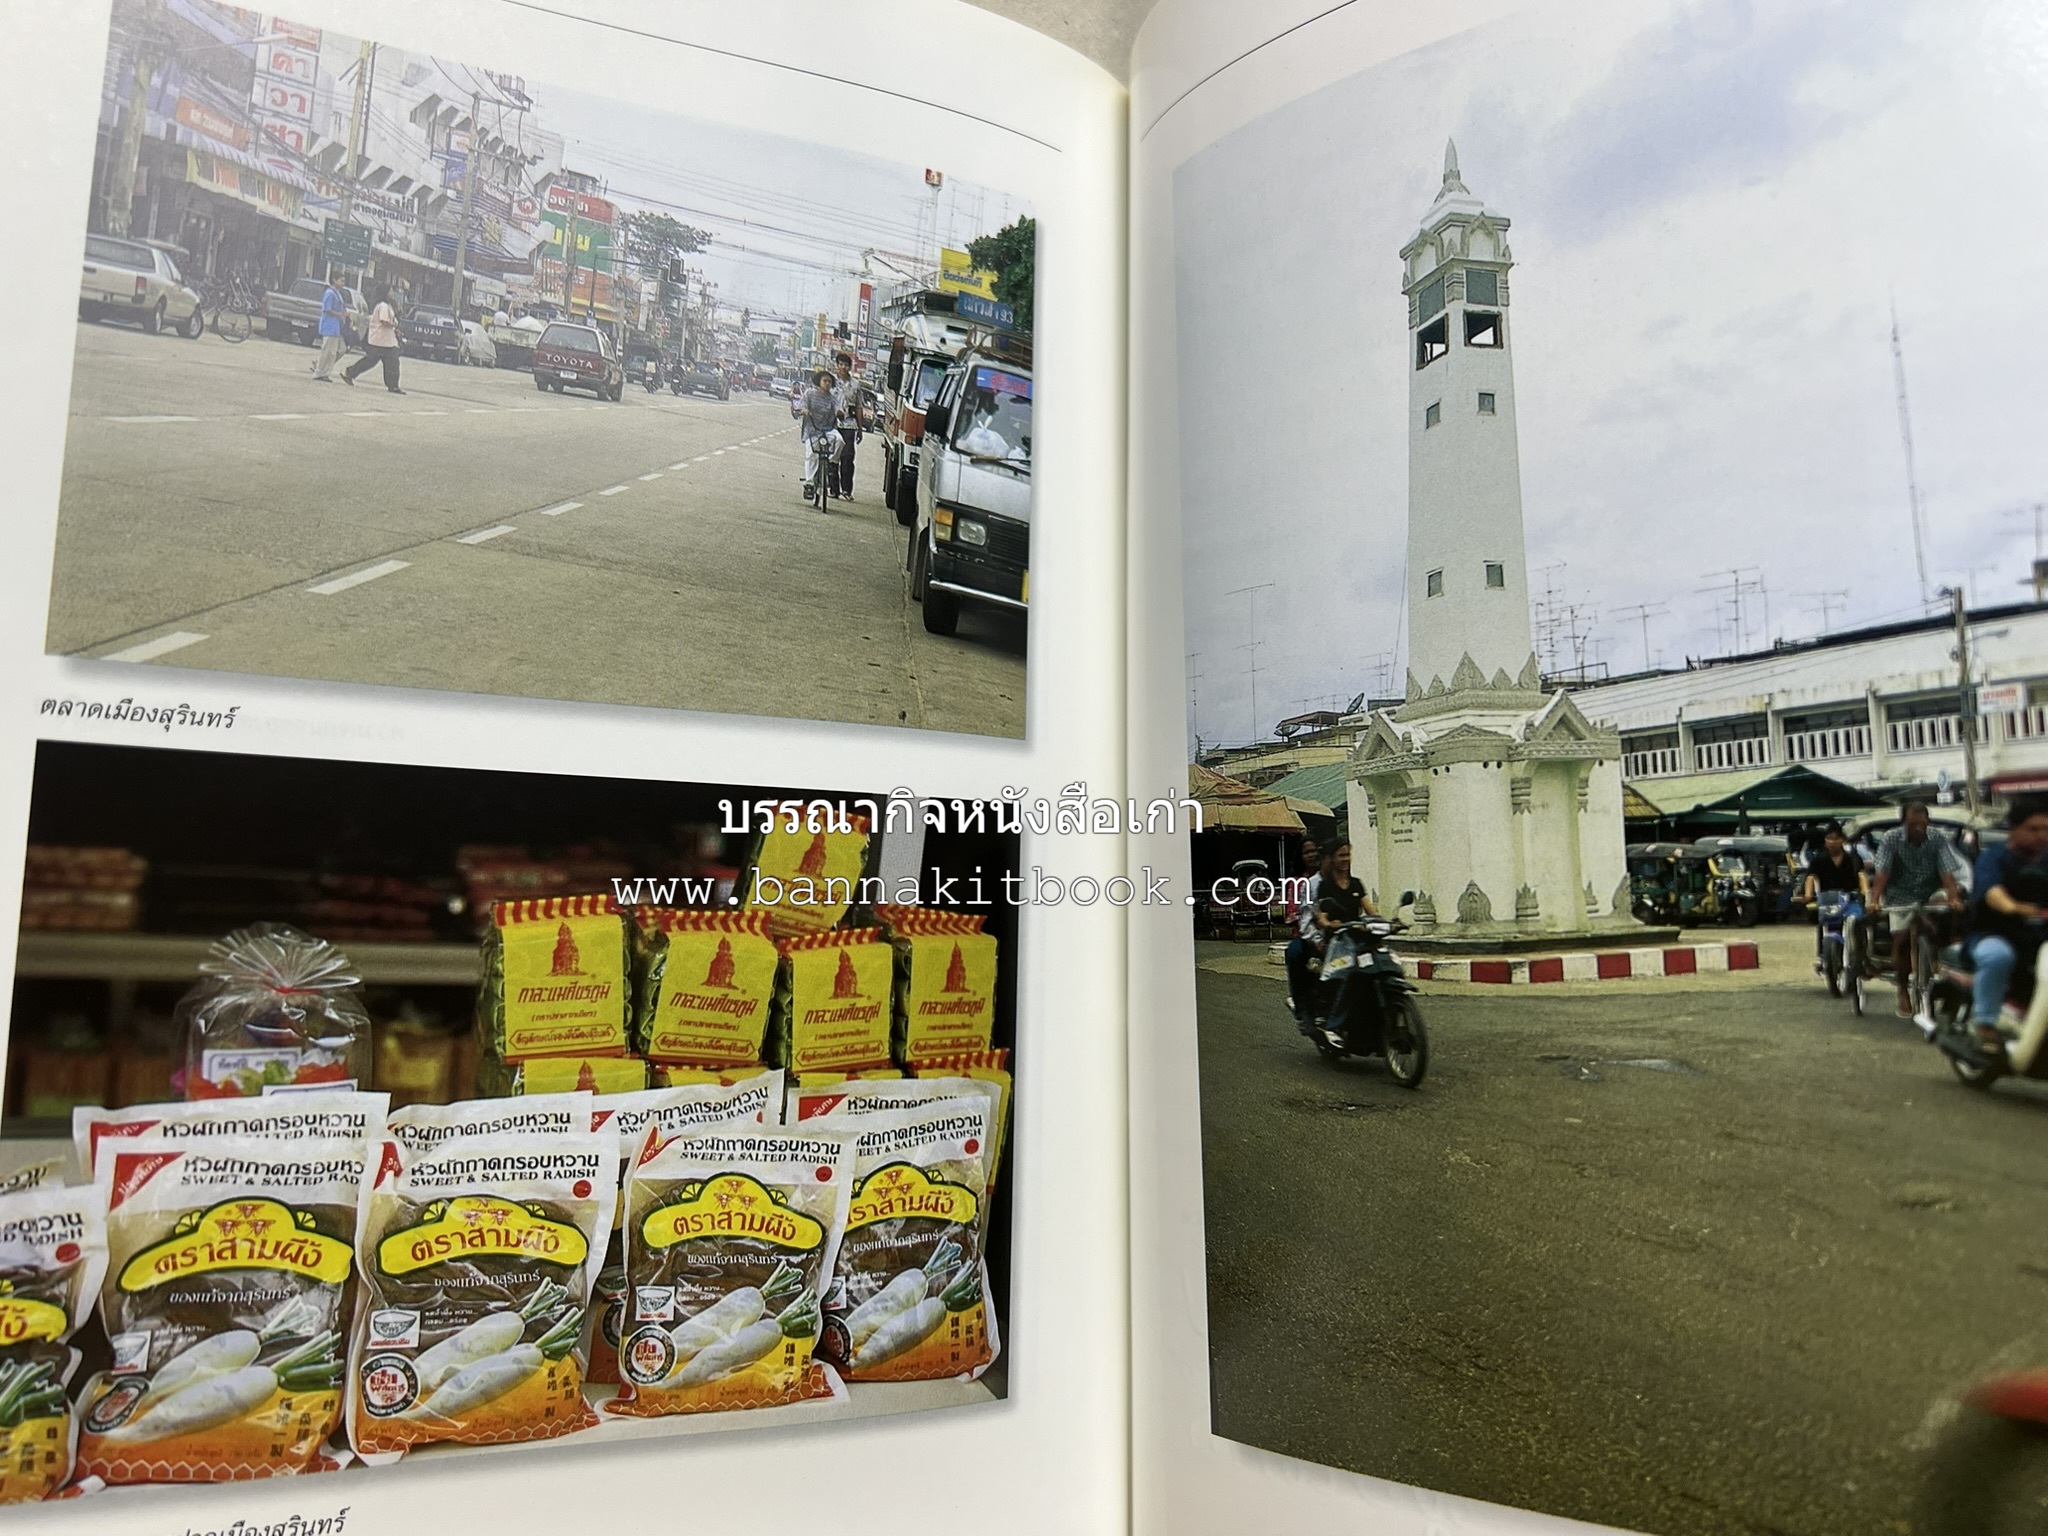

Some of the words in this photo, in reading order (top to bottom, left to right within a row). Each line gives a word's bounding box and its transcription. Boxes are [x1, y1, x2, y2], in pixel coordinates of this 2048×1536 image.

[414, 326, 443, 336] ISUZU
[545, 353, 593, 369] TOYOTA
[39, 697, 241, 733] ตลาดเมืองสุรินทร์
[679, 1113, 724, 1128] SALTED
[309, 1127, 363, 1139] RADISH
[894, 1135, 937, 1151] SALTED
[940, 1128, 982, 1141] RADISH
[411, 1154, 600, 1177] หัวผักกาดกรอบหวาน
[680, 1151, 723, 1162] SWEET
[728, 1154, 735, 1162] &
[738, 1152, 787, 1163] SALTED
[790, 1153, 837, 1165] RADISH
[181, 1174, 241, 1186] SWEET
[245, 1175, 255, 1185] &
[261, 1176, 324, 1187] SALTED
[410, 1175, 464, 1188] SWEET
[466, 1174, 476, 1184] &
[481, 1171, 539, 1183] SALTED
[543, 1168, 596, 1181] RADISH
[673, 1210, 797, 1241] ตราสามผึ้ง
